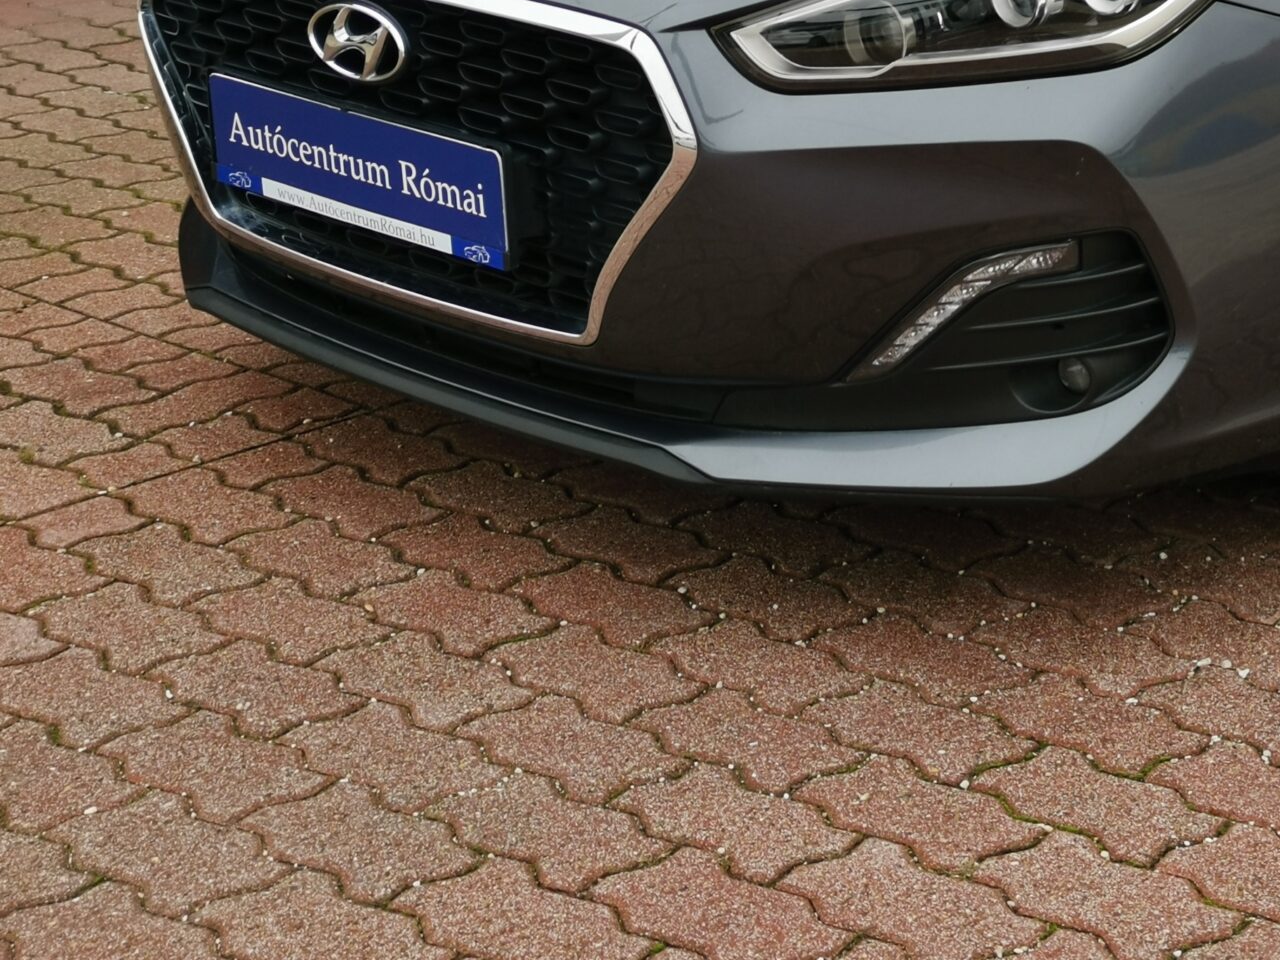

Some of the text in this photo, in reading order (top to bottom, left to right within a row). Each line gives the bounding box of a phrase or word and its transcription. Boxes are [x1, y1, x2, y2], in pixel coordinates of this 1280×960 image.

[229, 112, 487, 218] Autócentrum Római
[277, 187, 435, 247] www.AutócentrumRómai.hu
